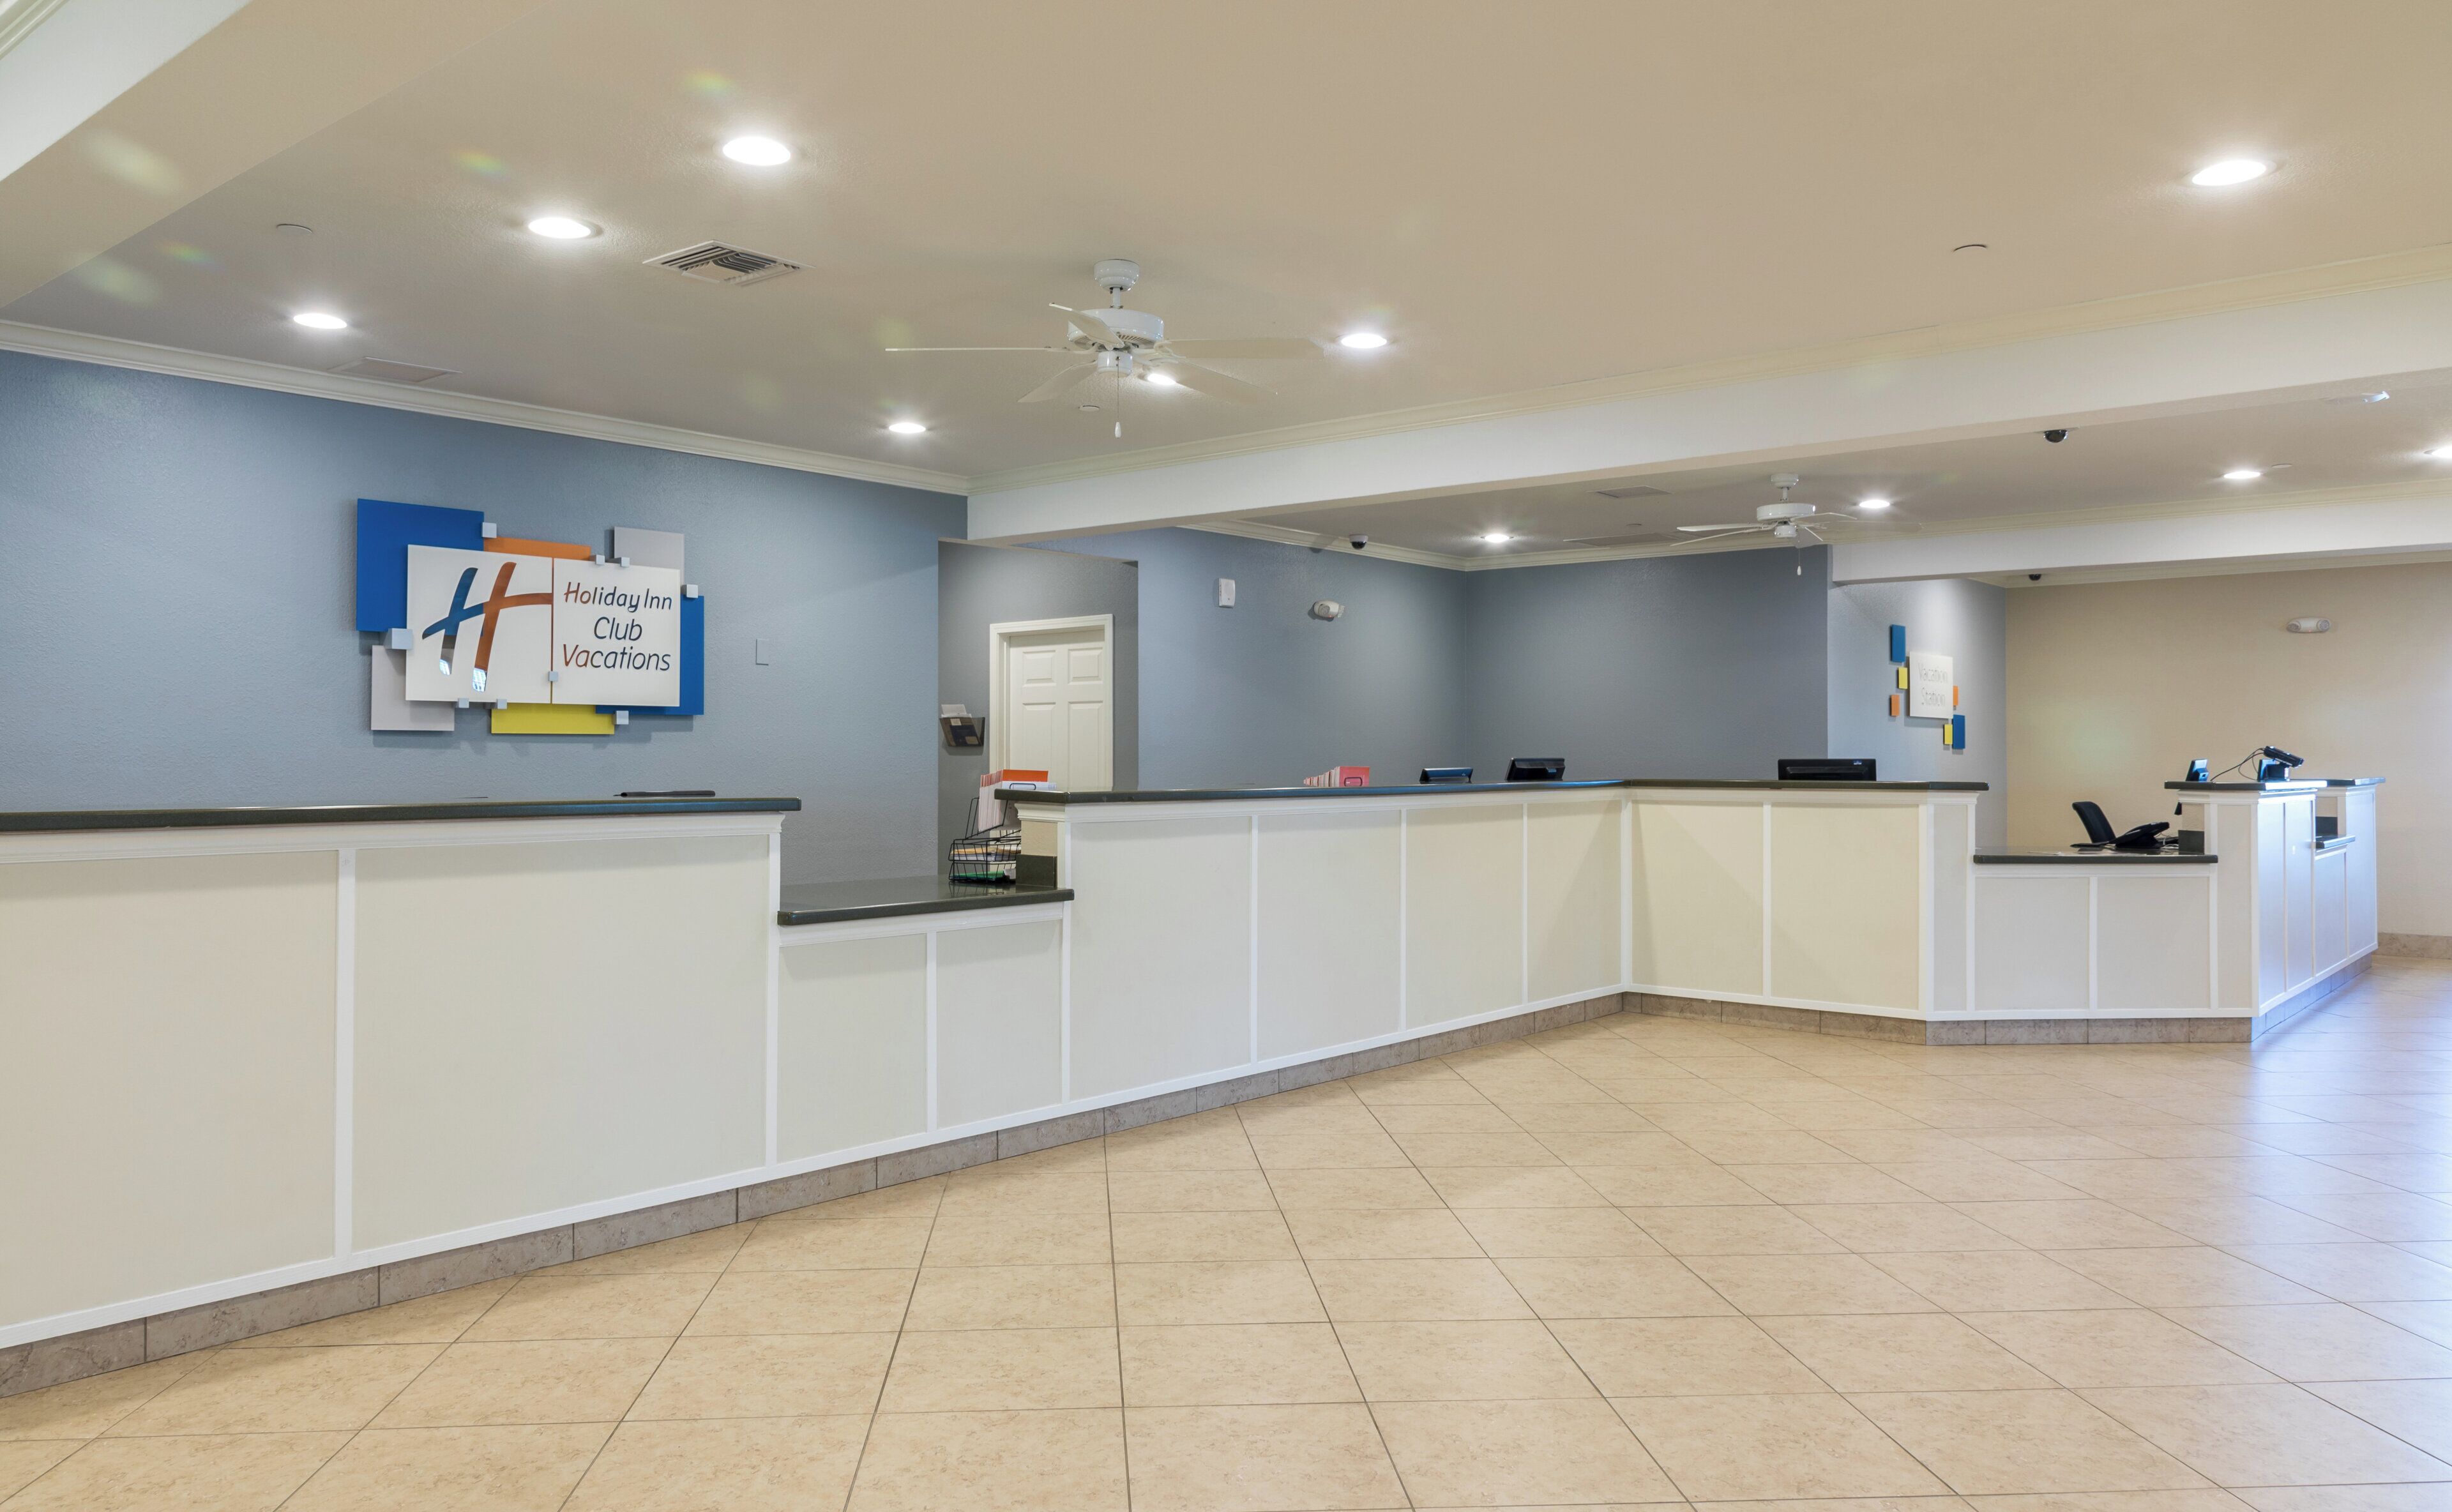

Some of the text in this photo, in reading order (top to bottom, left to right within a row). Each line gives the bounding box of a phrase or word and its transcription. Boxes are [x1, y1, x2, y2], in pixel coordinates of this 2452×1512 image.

[564, 582, 672, 612] Holiday Inn
[594, 616, 642, 641] Club
[563, 644, 671, 671] Vacations
[1918, 662, 1948, 684] Vacation
[1921, 686, 1946, 707] Station
